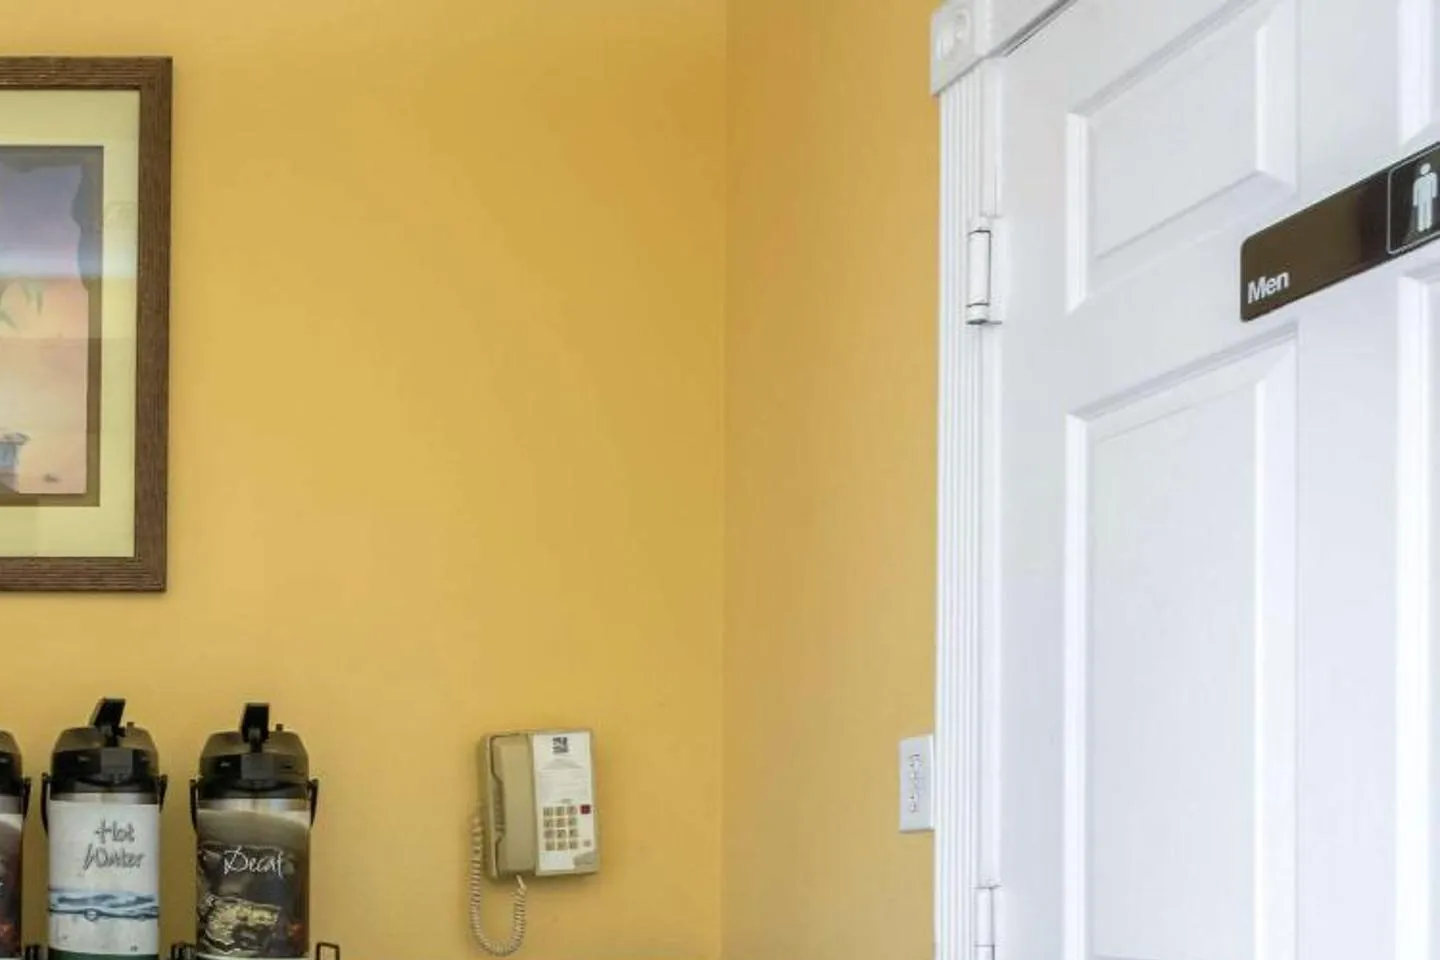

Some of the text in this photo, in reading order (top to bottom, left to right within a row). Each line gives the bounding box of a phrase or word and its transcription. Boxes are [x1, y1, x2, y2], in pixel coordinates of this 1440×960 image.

[1247, 271, 1291, 304] Men
[93, 816, 136, 845] Hot
[82, 843, 147, 872] Water
[223, 845, 284, 878] Decaf
